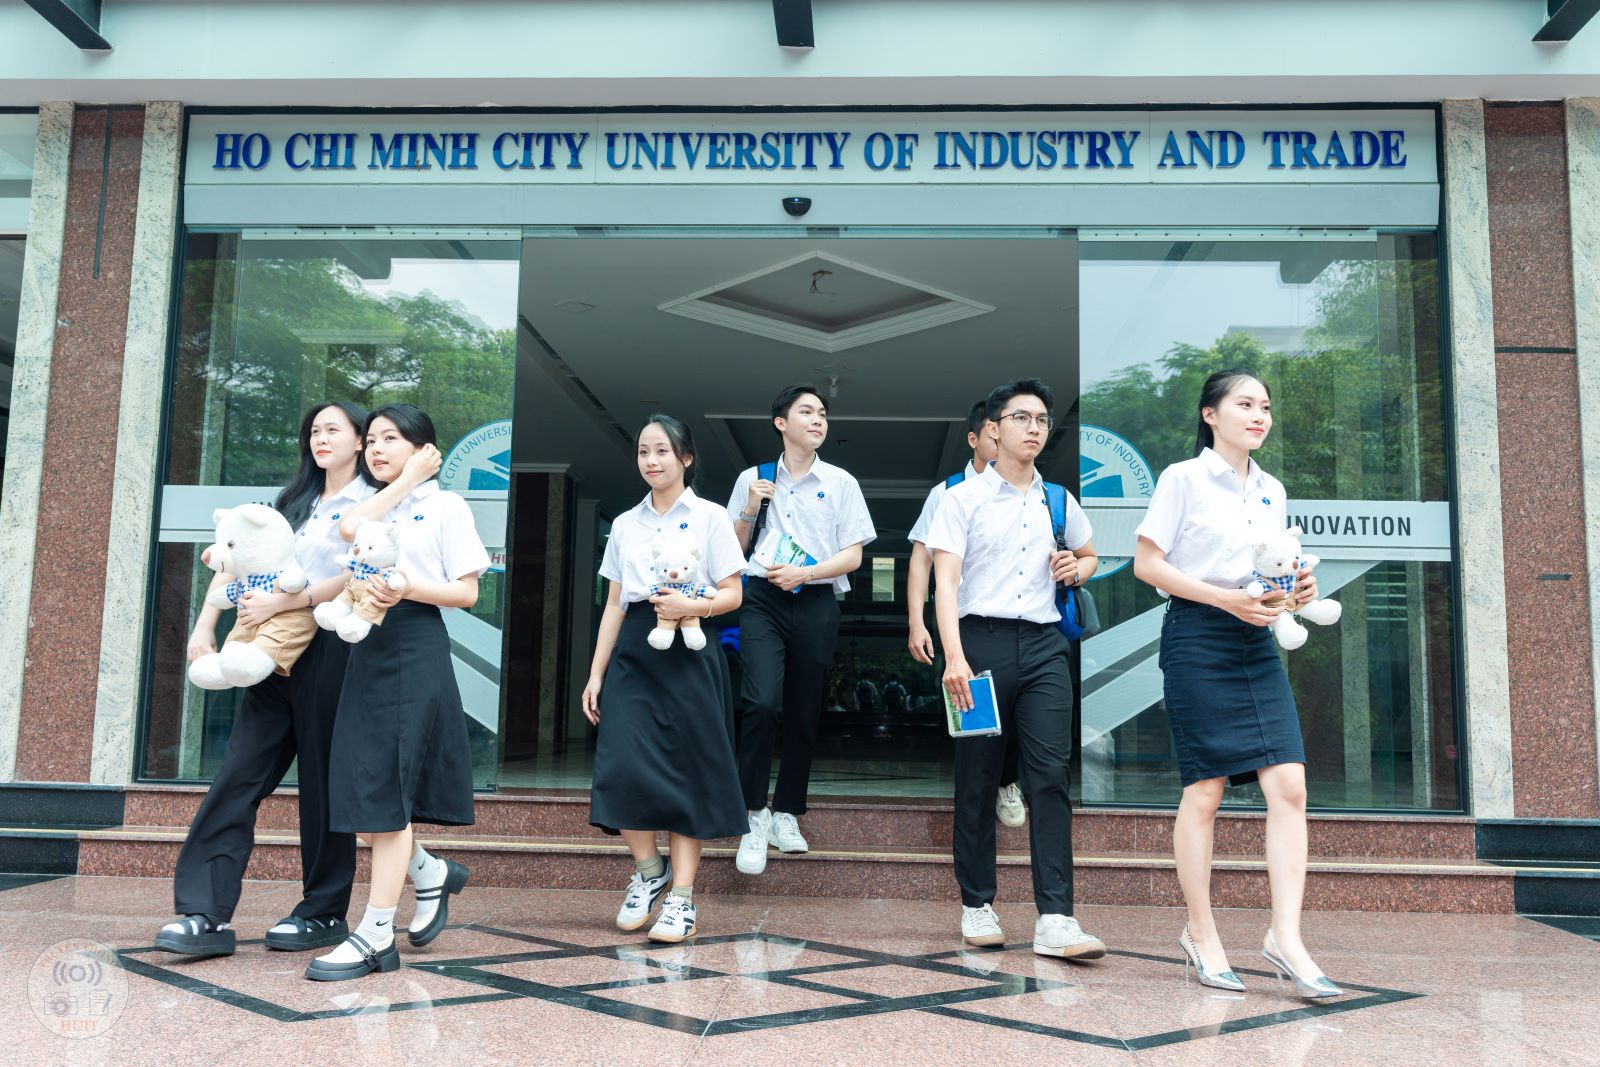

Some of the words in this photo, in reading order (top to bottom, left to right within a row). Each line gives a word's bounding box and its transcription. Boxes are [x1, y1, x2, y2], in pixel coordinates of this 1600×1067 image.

[213, 133, 272, 171] HO
[285, 133, 357, 171] CHI
[368, 133, 479, 171] MINH
[493, 132, 590, 170] CITY
[605, 132, 851, 171] UNIVERSITY
[864, 132, 919, 171] OF
[934, 131, 1141, 170] INDUSTRY
[1157, 131, 1246, 169] AND
[1263, 131, 1408, 169] TRADE
[445, 453, 463, 479] CITY
[1096, 434, 1113, 447] OF
[1112, 442, 1151, 497] INDUSTRY
